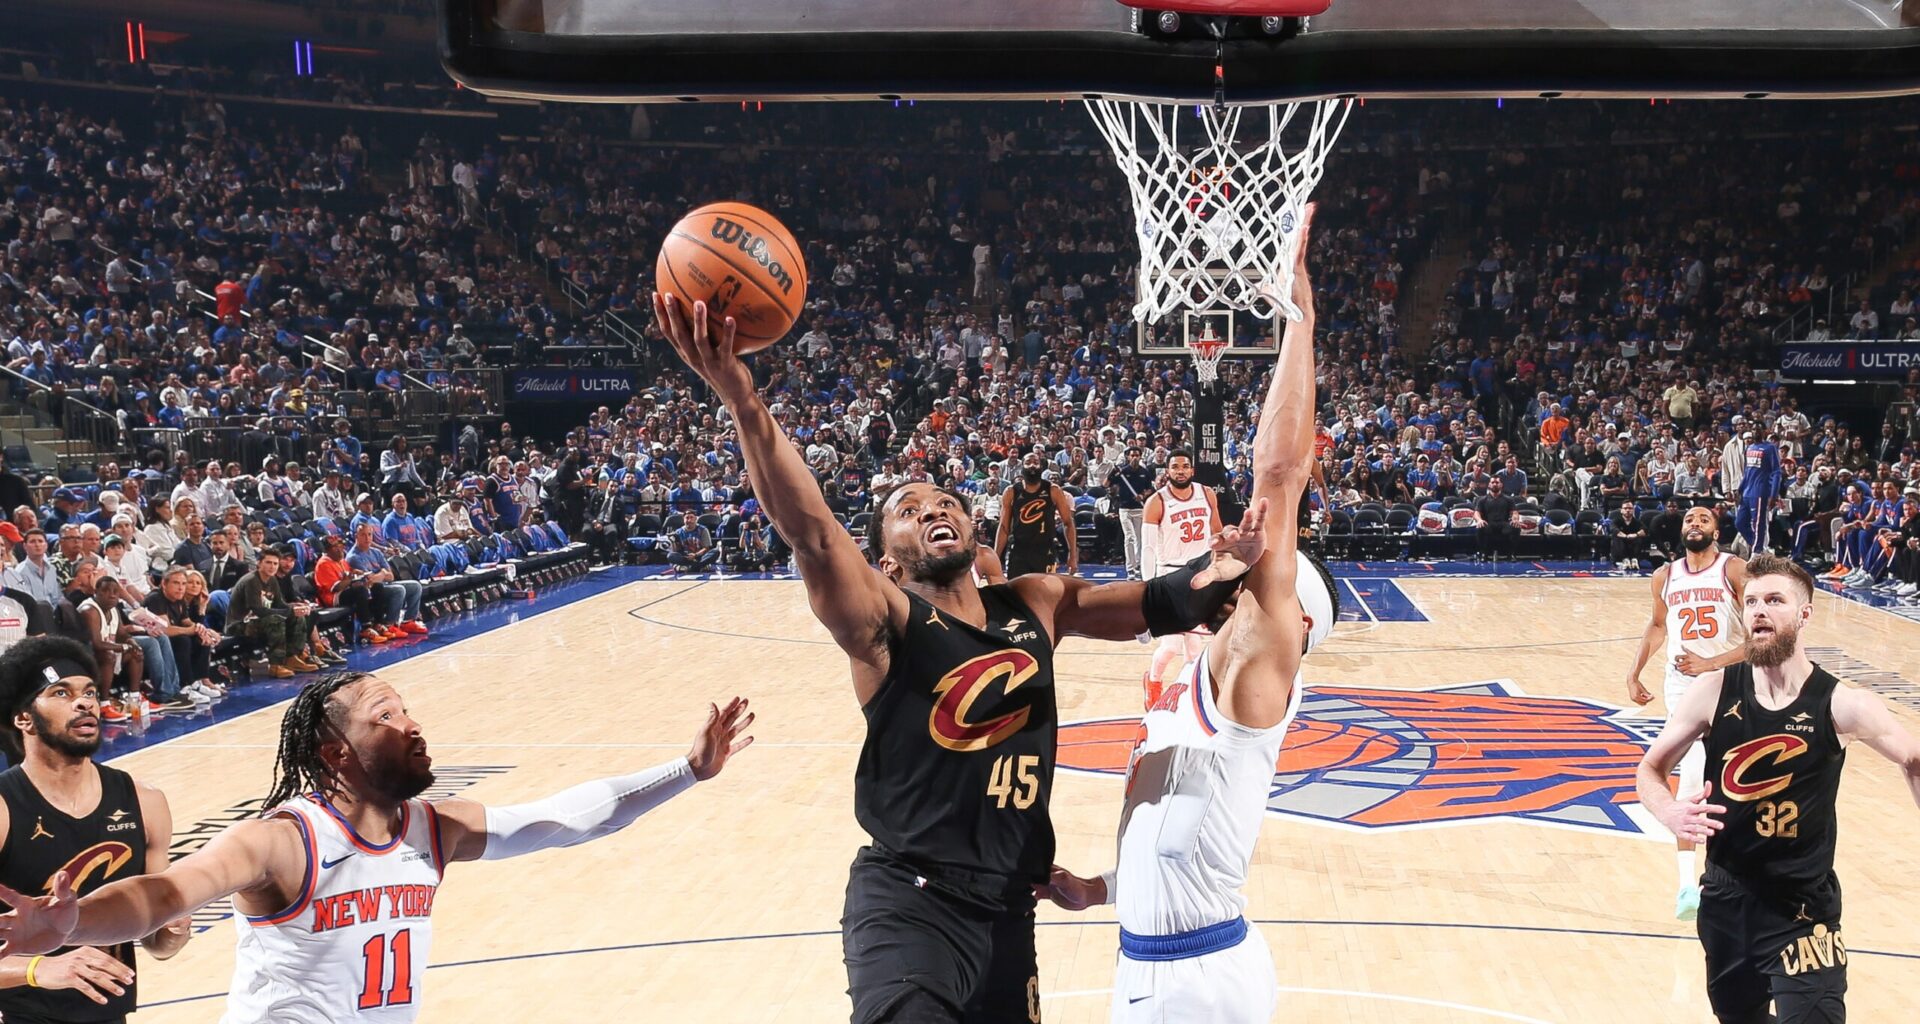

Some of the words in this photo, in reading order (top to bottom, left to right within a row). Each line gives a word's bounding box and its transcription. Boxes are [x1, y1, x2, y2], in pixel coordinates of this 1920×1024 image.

[711, 217, 793, 296] Wilson
[1781, 351, 1843, 369] Michelob
[515, 376, 568, 393] Michelob
[581, 378, 631, 391] ULTRA
[1202, 423, 1216, 436] GET
[1202, 436, 1216, 449] THE
[1020, 499, 1047, 524] C
[1170, 510, 1188, 524] NEW
[1038, 522, 1046, 534] 1
[1180, 519, 1205, 543] 32
[1668, 588, 1692, 606] NEW
[1692, 587, 1726, 603] YORK
[1678, 605, 1719, 640] 25
[1008, 630, 1038, 643] LIFFS
[928, 648, 1040, 752] C
[1784, 723, 1815, 733] CLIFFS
[1720, 733, 1808, 802] C
[986, 754, 1040, 810] 45
[106, 822, 137, 832] CLIFFS
[1755, 801, 1799, 839] 32
[312, 885, 383, 933] NEW
[1779, 926, 1848, 977] CAVS
[357, 927, 413, 1011] 11
